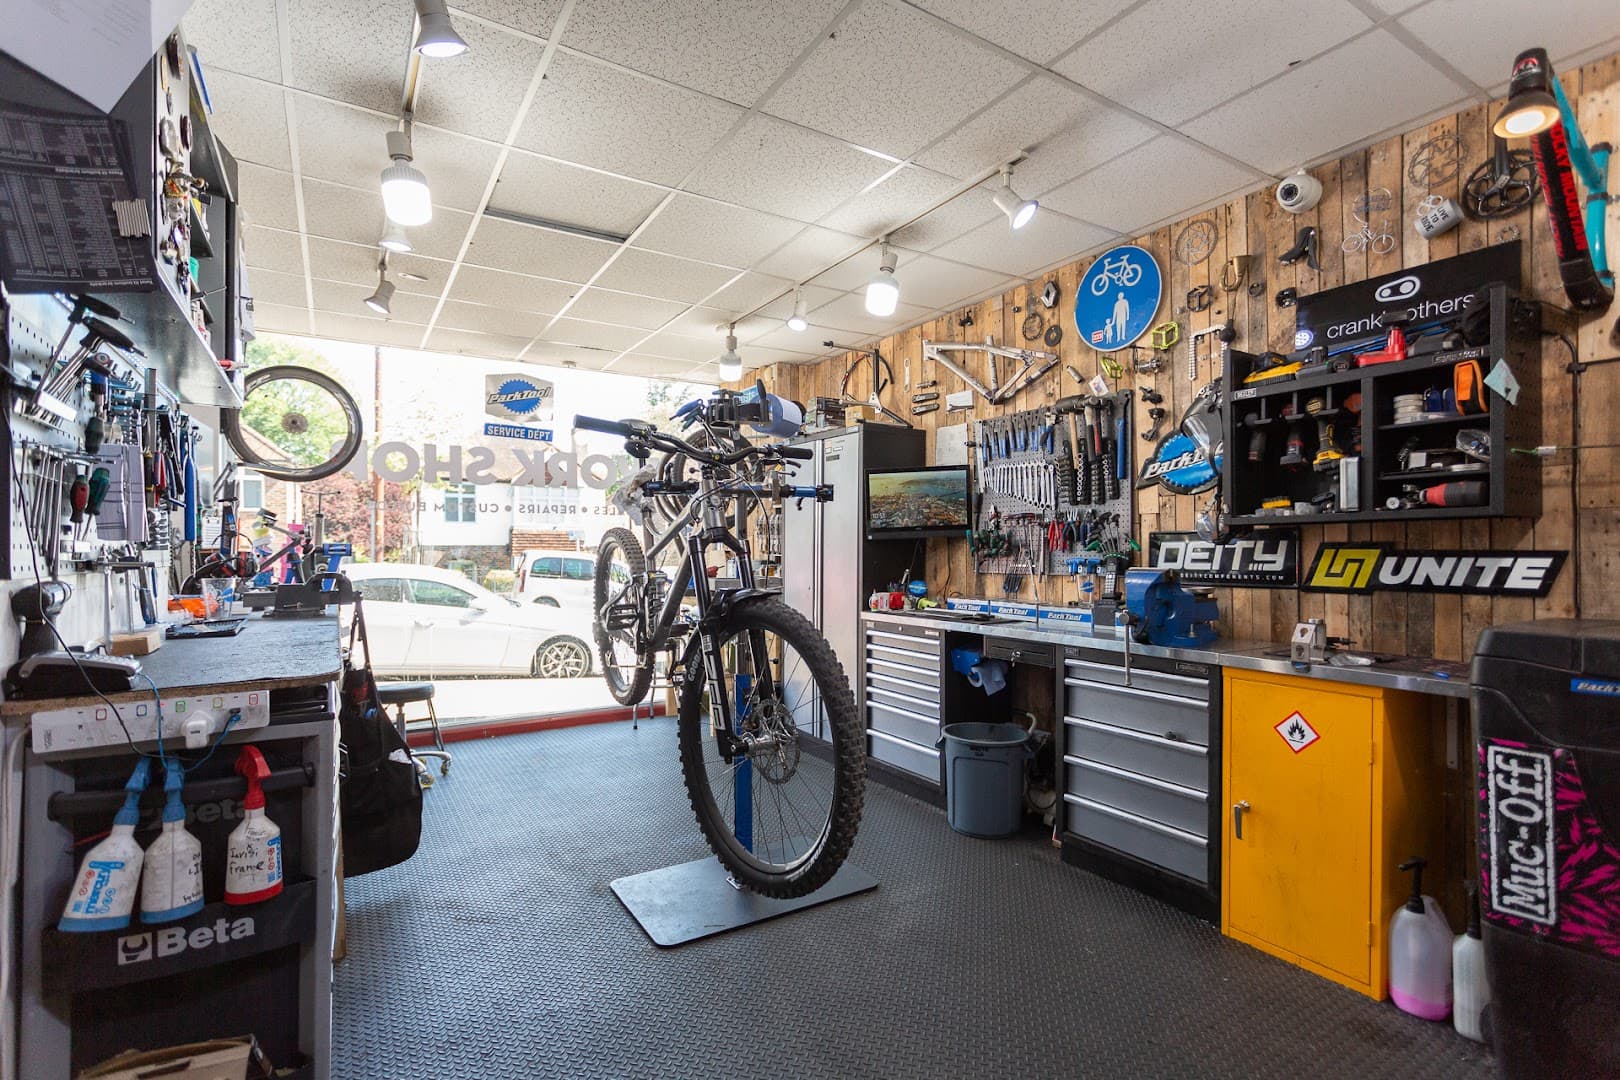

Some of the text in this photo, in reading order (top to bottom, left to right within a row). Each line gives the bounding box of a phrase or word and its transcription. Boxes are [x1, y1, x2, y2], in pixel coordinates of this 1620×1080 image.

[1421, 215, 1434, 232] RIDE
[1430, 214, 1439, 223] TO
[1436, 206, 1450, 220] LIVE
[1560, 169, 1588, 251] MOUNTAIN
[1327, 294, 1475, 339] crankothers
[487, 425, 551, 441] SERVICE DEPT
[1157, 540, 1289, 572] DEITY
[1378, 556, 1554, 590] UNITE
[1495, 753, 1546, 915] Muc-Off
[156, 916, 256, 958] Beta
